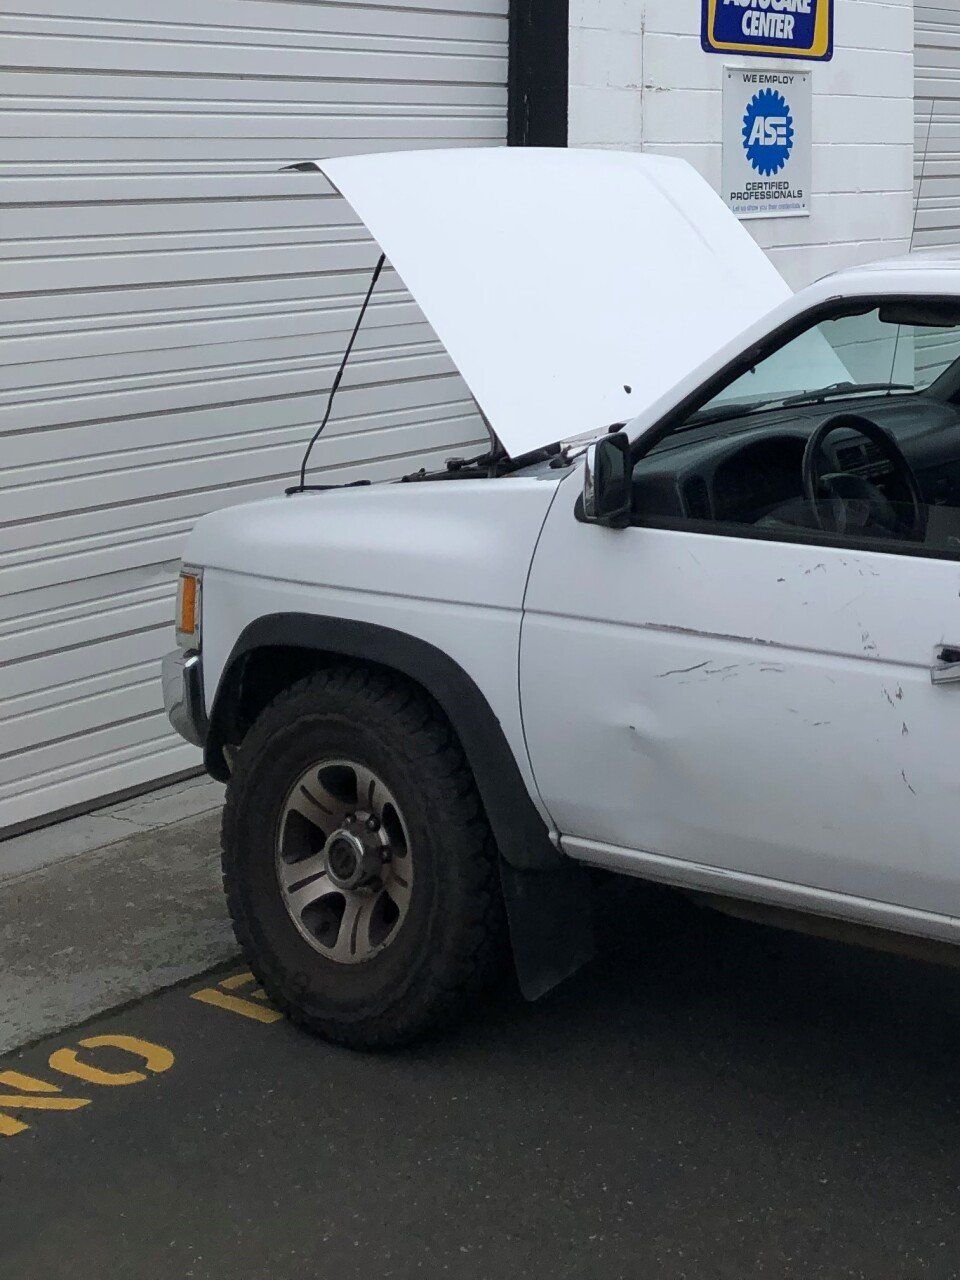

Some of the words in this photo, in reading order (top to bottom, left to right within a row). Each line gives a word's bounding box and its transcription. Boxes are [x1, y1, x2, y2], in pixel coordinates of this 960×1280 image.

[741, 10, 795, 40] CENTER
[743, 74, 757, 83] WE
[758, 74, 795, 85] EMPLOY
[748, 116, 787, 146] ASE
[745, 181, 790, 191] CERTIFIED
[730, 189, 803, 201] PROFESSIONALS
